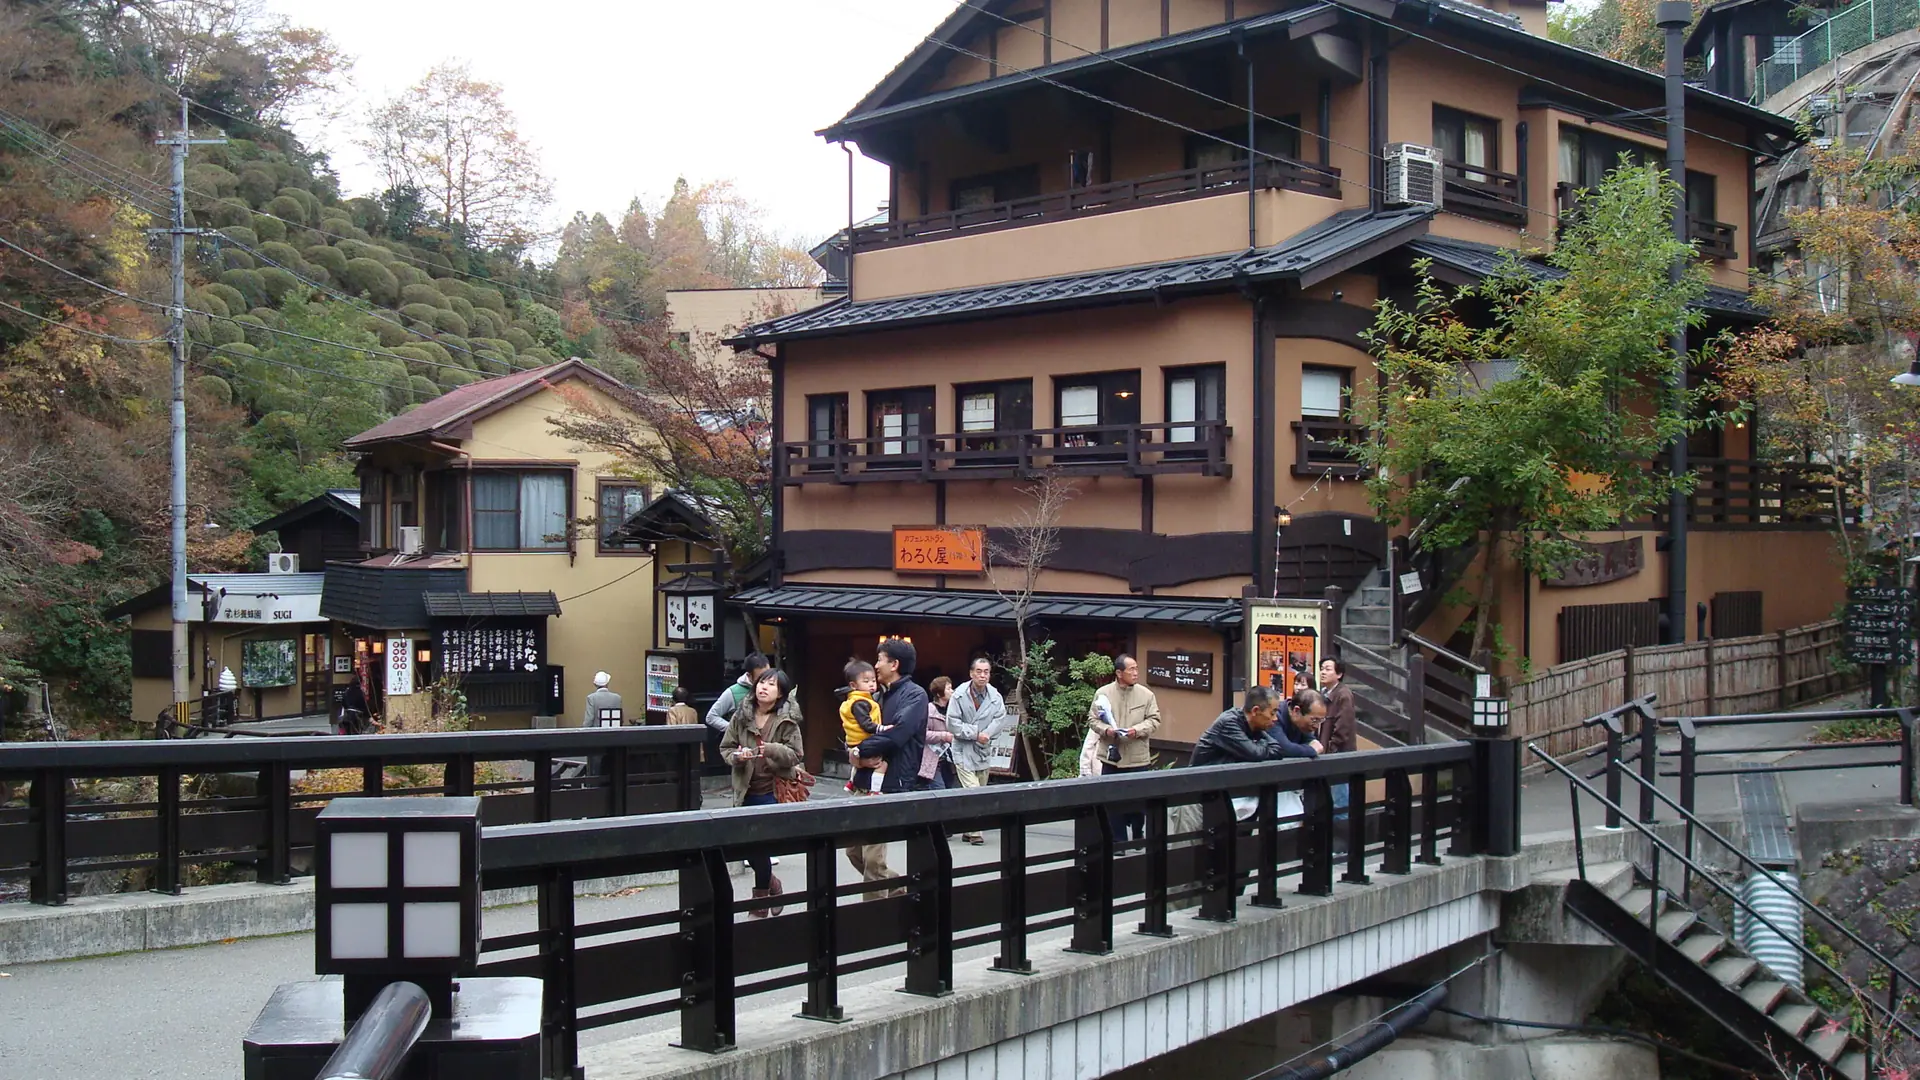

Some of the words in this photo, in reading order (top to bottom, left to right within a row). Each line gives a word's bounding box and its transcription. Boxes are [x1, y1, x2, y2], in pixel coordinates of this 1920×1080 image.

[903, 533, 945, 544] カフェレストラン
[900, 546, 949, 565] わろく屋
[273, 610, 292, 620] SUGI
[689, 612, 712, 633] なか
